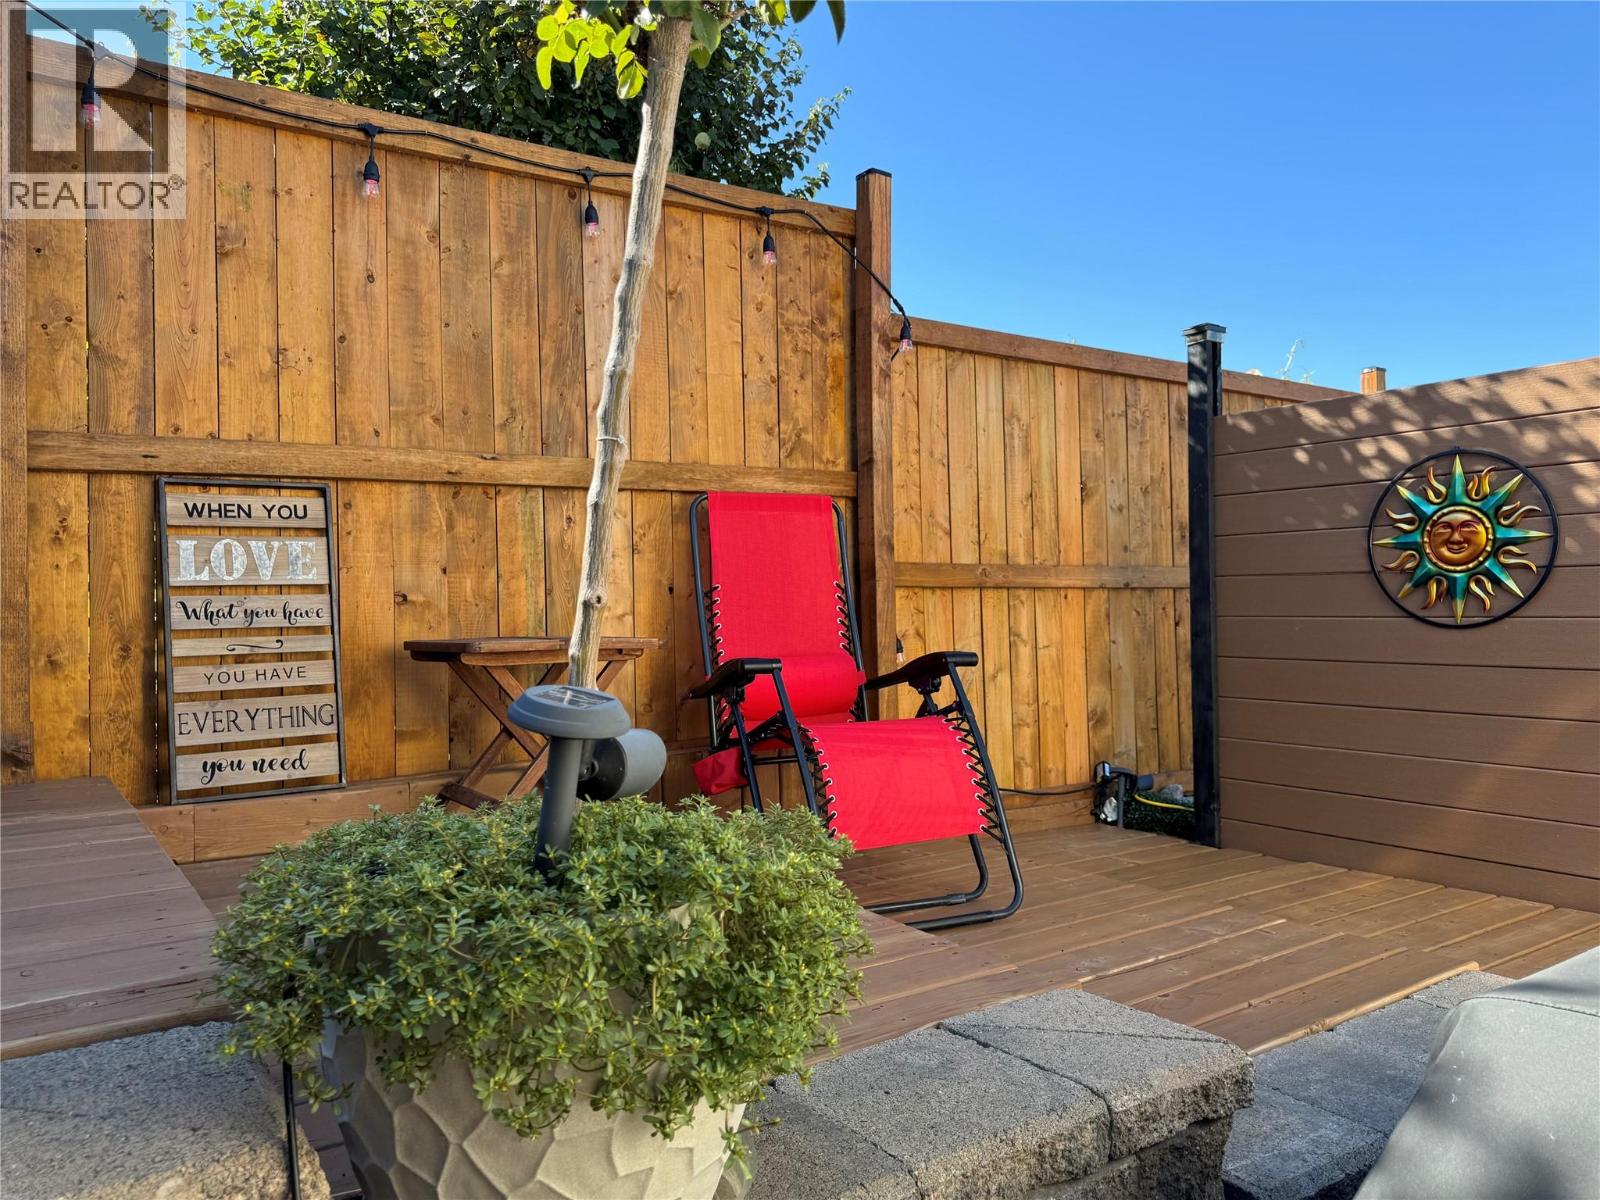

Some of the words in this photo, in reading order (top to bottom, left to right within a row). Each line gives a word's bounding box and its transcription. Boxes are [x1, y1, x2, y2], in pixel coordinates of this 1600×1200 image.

[184, 502, 252, 519] WHEN
[262, 504, 307, 520] YOU
[175, 538, 317, 581] LOVE
[176, 599, 245, 626] What
[243, 602, 277, 627] you
[282, 601, 325, 626] have
[203, 671, 245, 685] YOU
[255, 666, 307, 681] HAVE
[177, 703, 335, 736] EVERYTHING
[201, 757, 245, 785] you
[252, 748, 310, 773] need
